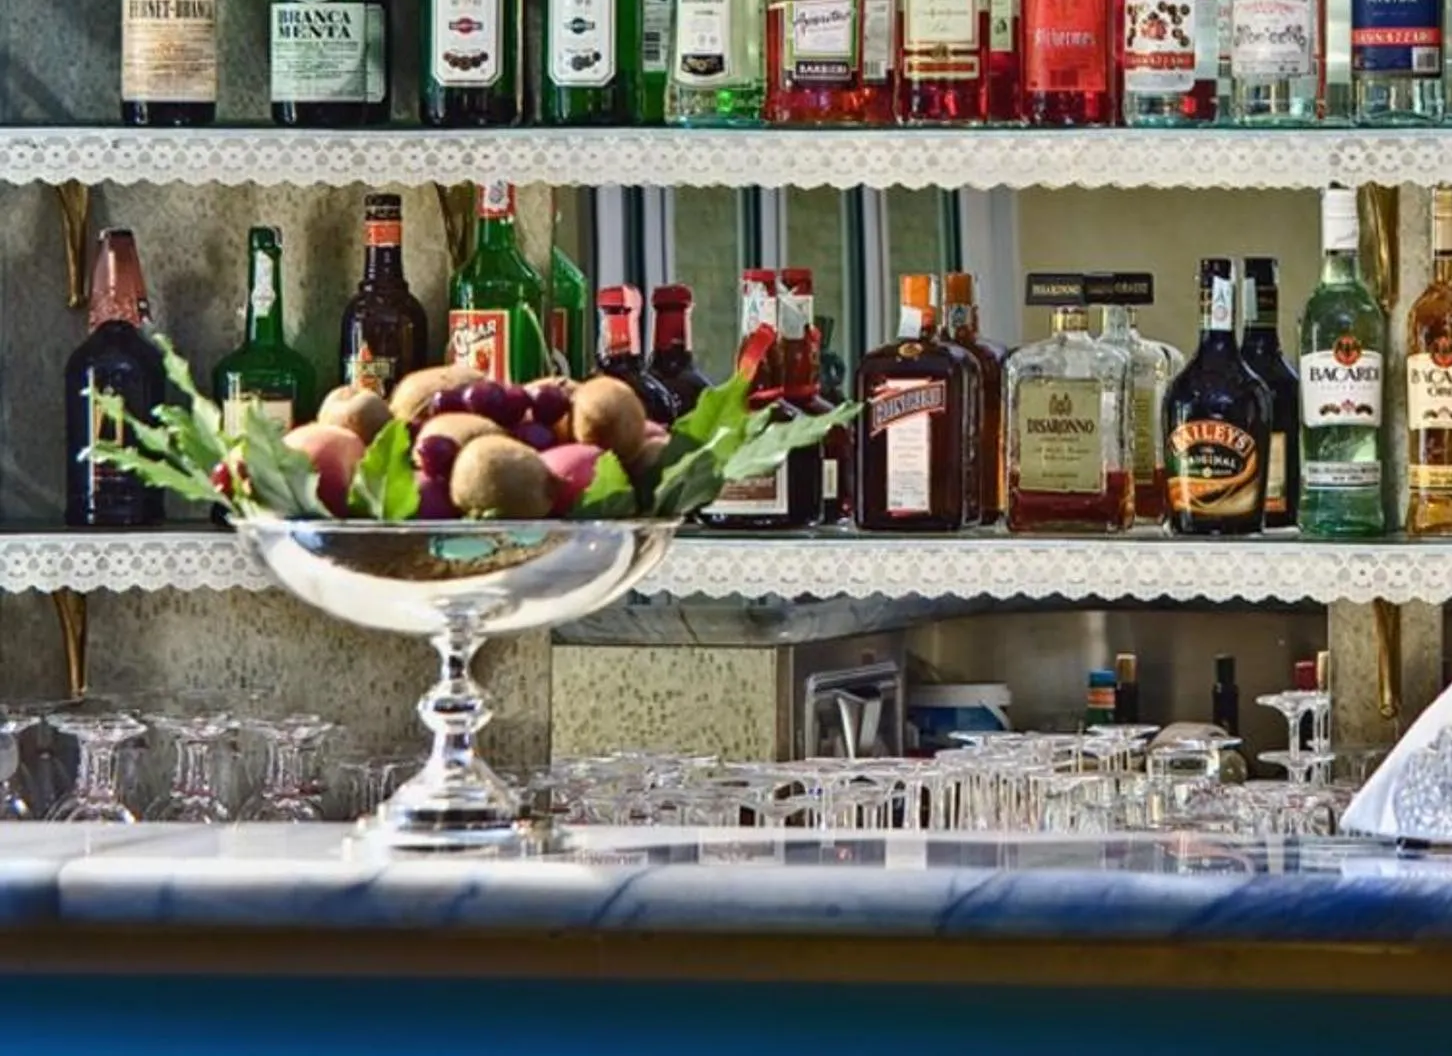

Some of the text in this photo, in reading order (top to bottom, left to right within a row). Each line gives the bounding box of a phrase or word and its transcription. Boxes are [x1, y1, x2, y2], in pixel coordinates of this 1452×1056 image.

[279, 10, 351, 24] BRANCA
[279, 25, 351, 39] MENTA
[1310, 366, 1379, 382] BACARDI
[1027, 418, 1095, 435] DISARONNO
